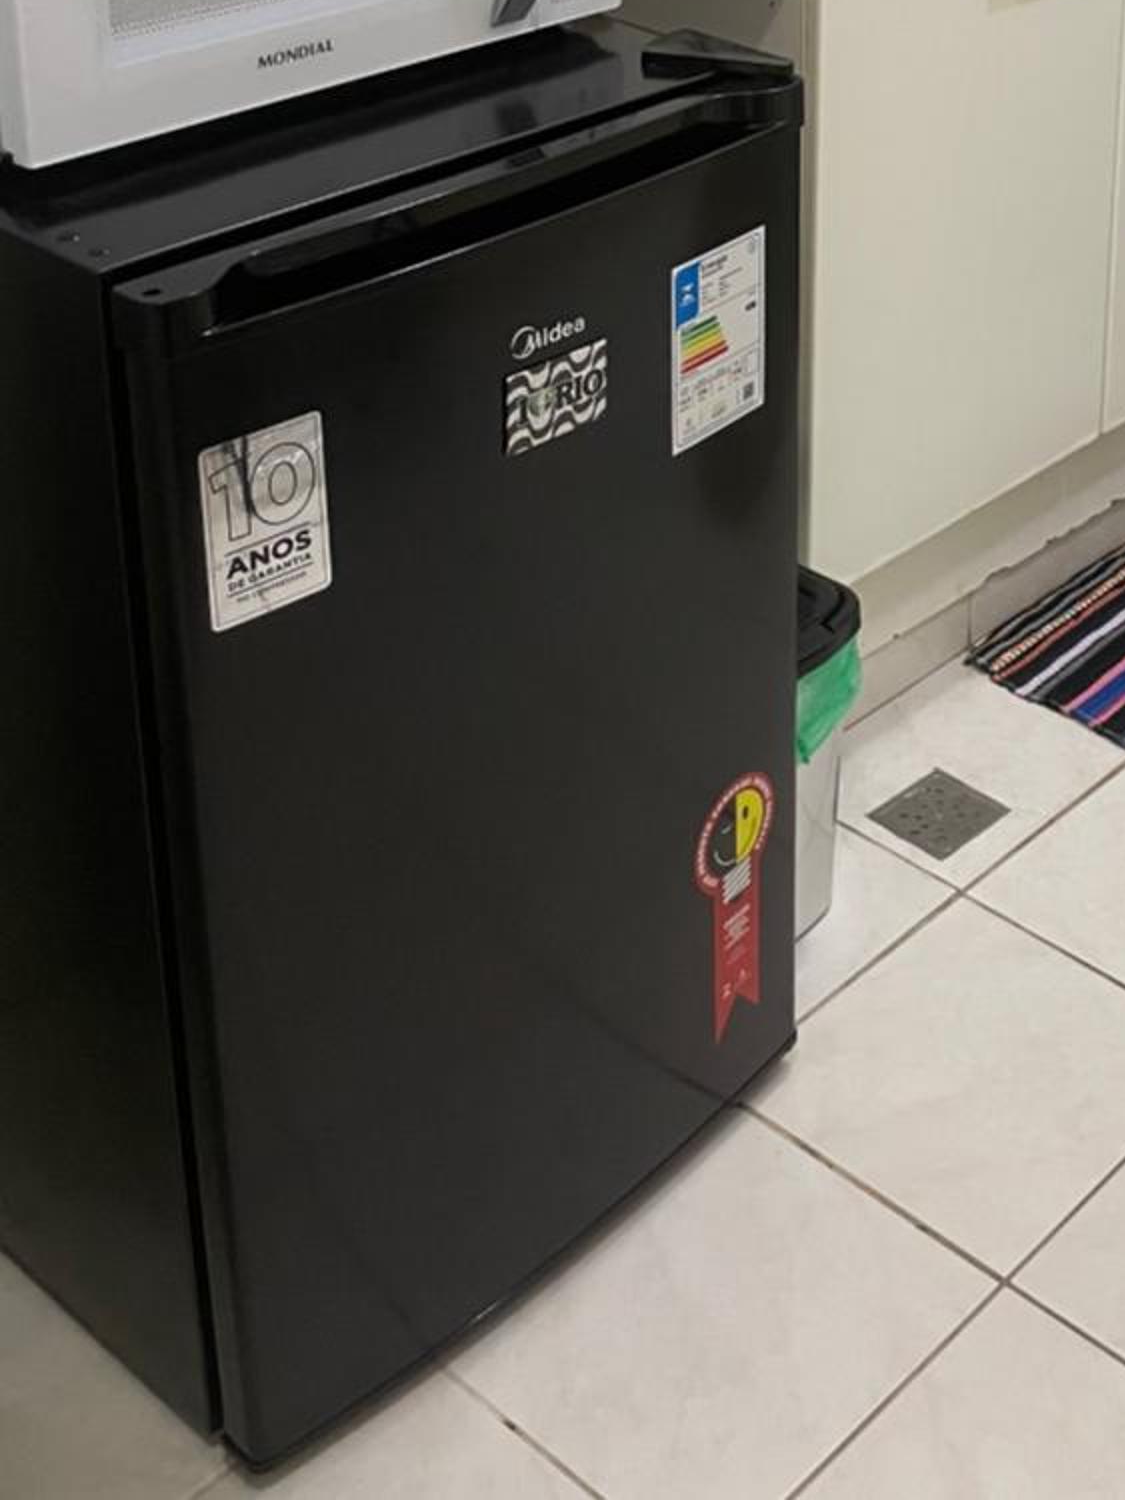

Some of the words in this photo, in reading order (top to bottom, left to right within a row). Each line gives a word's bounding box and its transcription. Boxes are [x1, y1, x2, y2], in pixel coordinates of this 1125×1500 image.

[257, 39, 333, 69] MONDIAL
[511, 317, 585, 359] Midea
[556, 368, 602, 408] RIO
[208, 441, 316, 542] 10
[226, 529, 312, 580] ANOS
[228, 579, 246, 593] DE
[249, 553, 312, 583] GARANTIA
